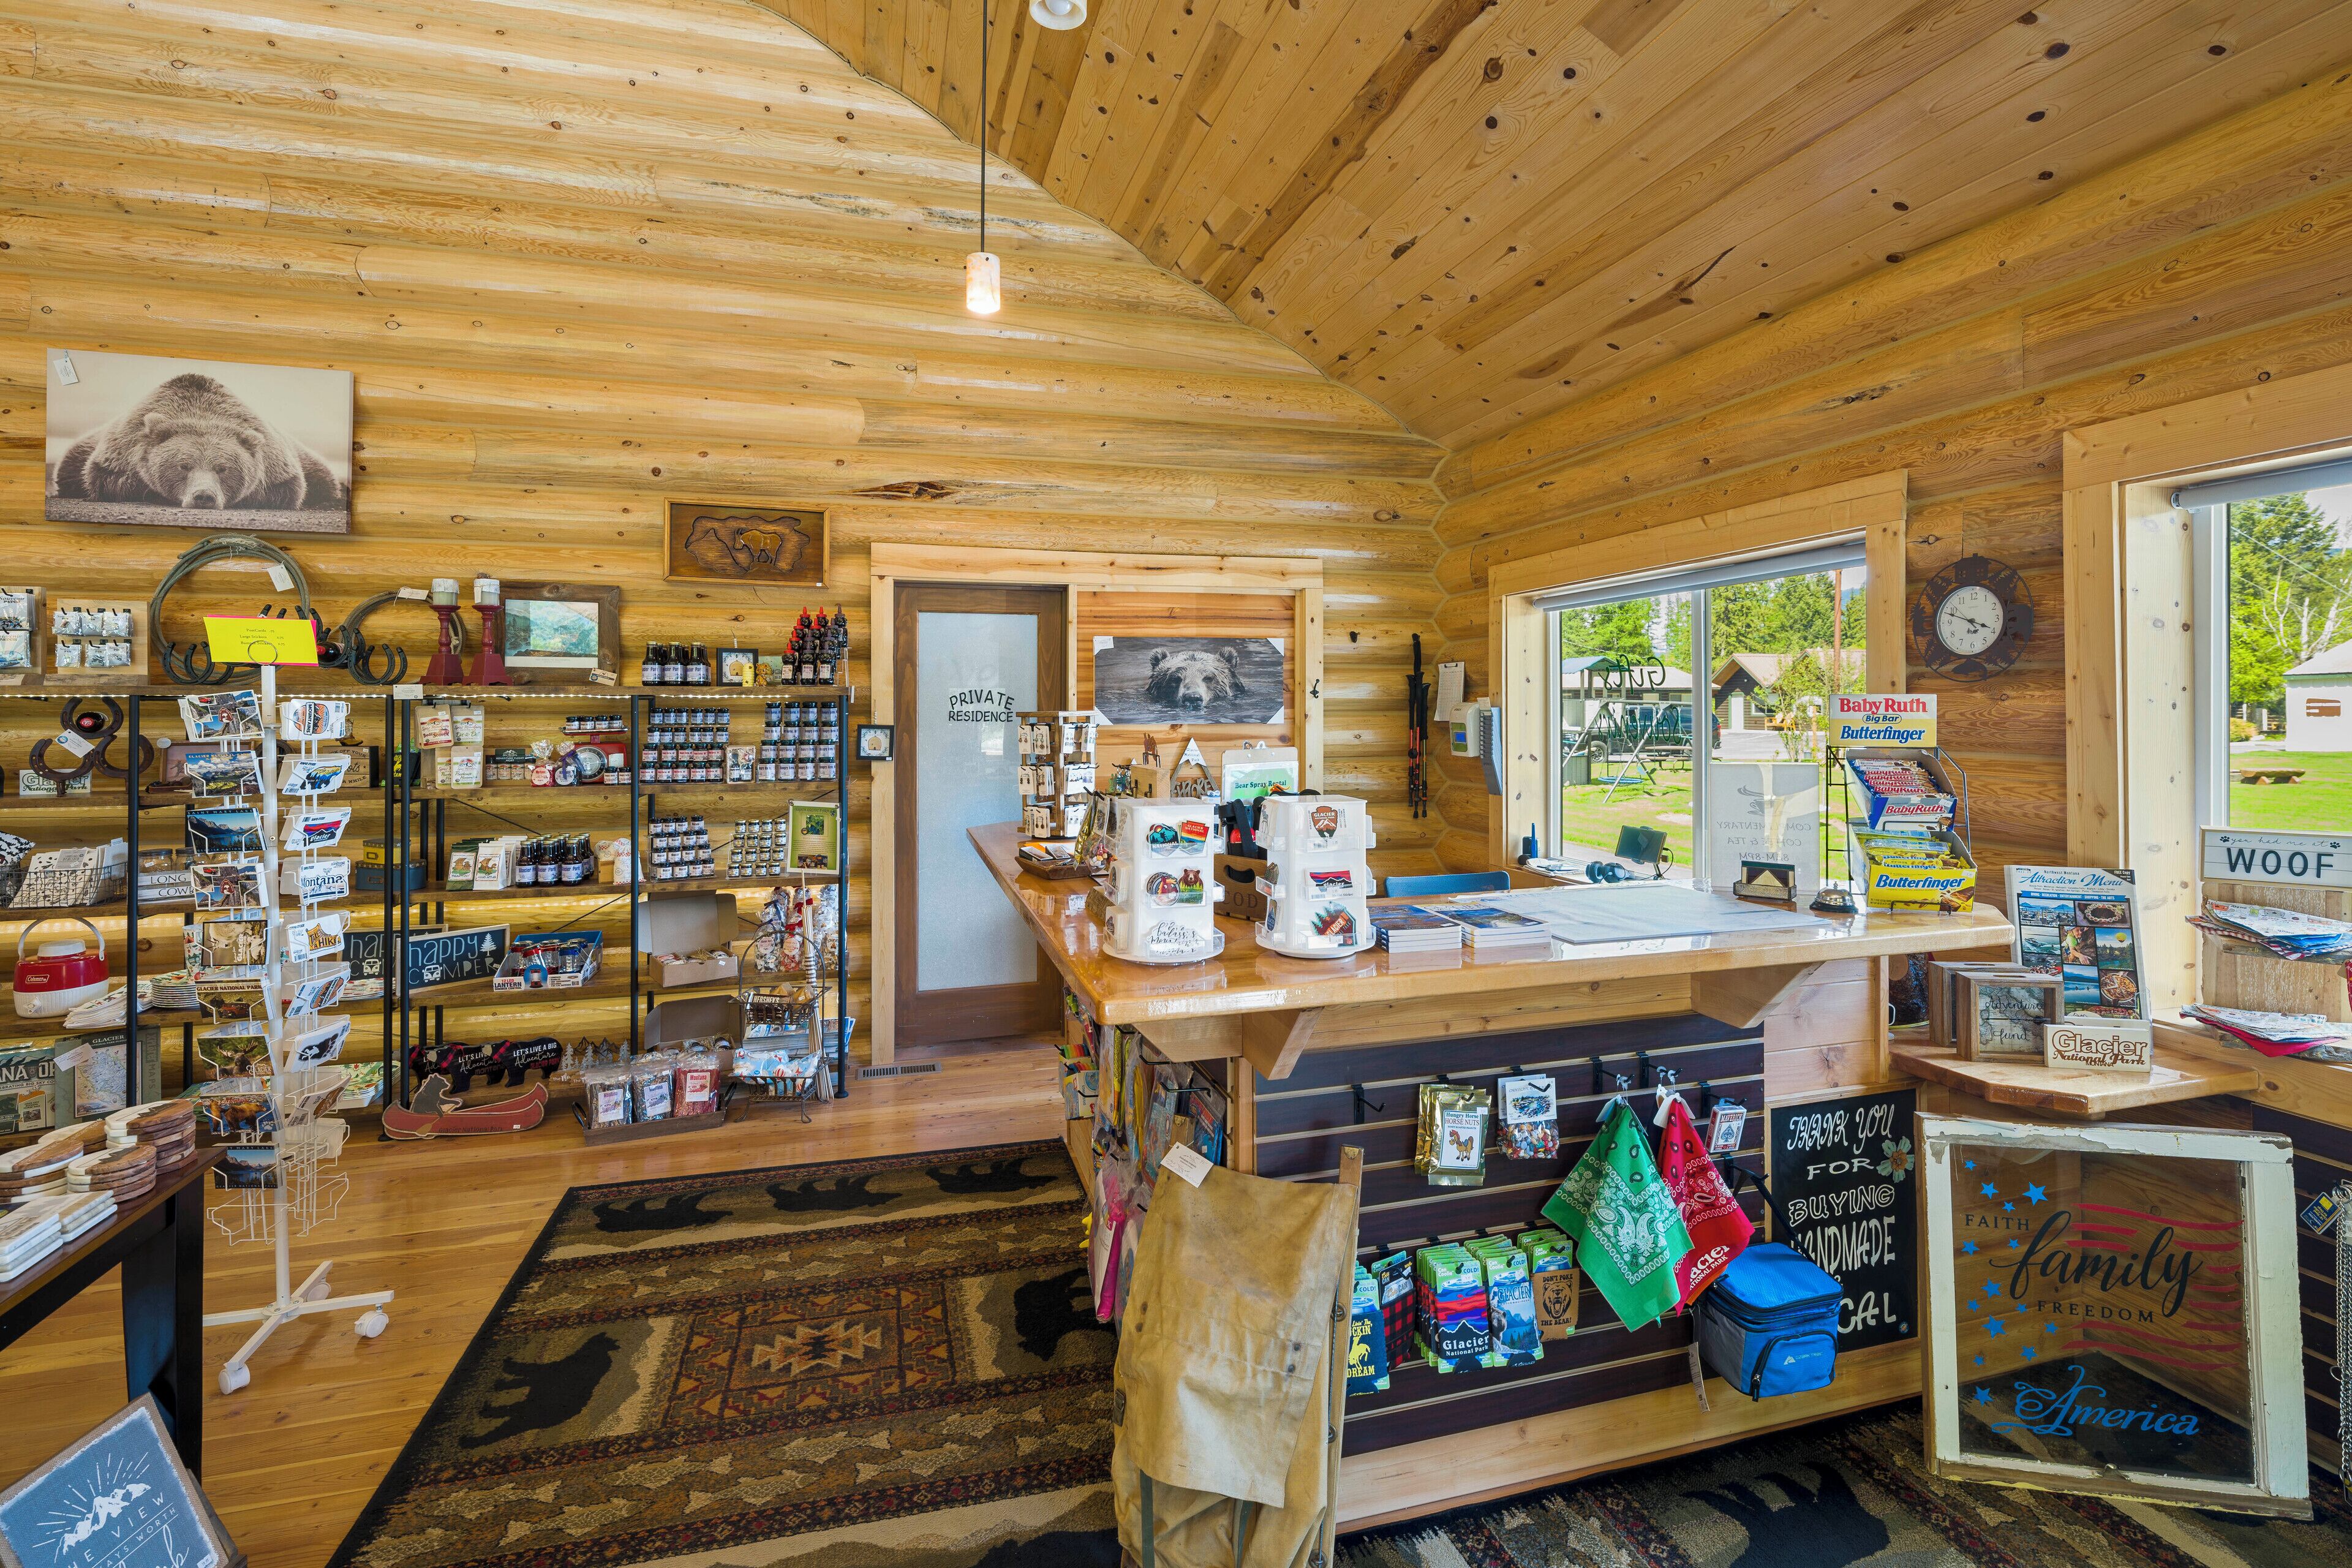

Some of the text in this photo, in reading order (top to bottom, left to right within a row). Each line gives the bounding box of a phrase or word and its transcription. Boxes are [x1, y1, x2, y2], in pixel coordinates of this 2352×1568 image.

[949, 689, 1014, 710] PRIVATE
[1838, 698, 1928, 715] Baby Ruth
[949, 710, 1014, 722] RESIDENCE
[1840, 725, 1926, 744] Butterfinger
[352, 750, 366, 758] YOUR
[2231, 837, 2252, 847] you
[2258, 837, 2282, 845] had
[2226, 847, 2334, 879] WOOF
[151, 874, 186, 884] LONG
[301, 875, 343, 888] Montana
[1875, 873, 1966, 891] Butterfinger
[2019, 871, 2077, 884] Attraction
[2080, 873, 2124, 886] Menu
[310, 933, 319, 944] TAKE
[409, 935, 478, 968] happy
[1985, 996, 2044, 1010] Adventure
[92, 1034, 124, 1044] GLACIER
[1992, 1028, 2030, 1045] fund
[2052, 1030, 2148, 1057] Glacier
[513, 1049, 529, 1057] LET'S
[529, 1046, 542, 1054] LIVE
[514, 1050, 557, 1068] Adventure
[2052, 1050, 2146, 1065] National Park
[1720, 1113, 1743, 1123] MAVERICK
[1787, 1104, 1895, 1155] THANK YOU
[1807, 1158, 1874, 1181] FOR
[1789, 1183, 1895, 1227] BUYING
[1965, 1214, 2030, 1231] FAITH
[1711, 1254, 1728, 1271] PARK
[1989, 1210, 2203, 1318] family
[1498, 1285, 1530, 1302] GLACIER
[1837, 1291, 1896, 1334] CAL
[2037, 1300, 2154, 1324] FREEDOM
[1442, 1335, 1490, 1350] Glacier
[1446, 1348, 1474, 1356] National
[1347, 1365, 1375, 1378] DREAM
[1991, 1365, 2199, 1437] America
[111, 1493, 164, 1538] VIEW
[136, 1508, 176, 1542] WORTH
